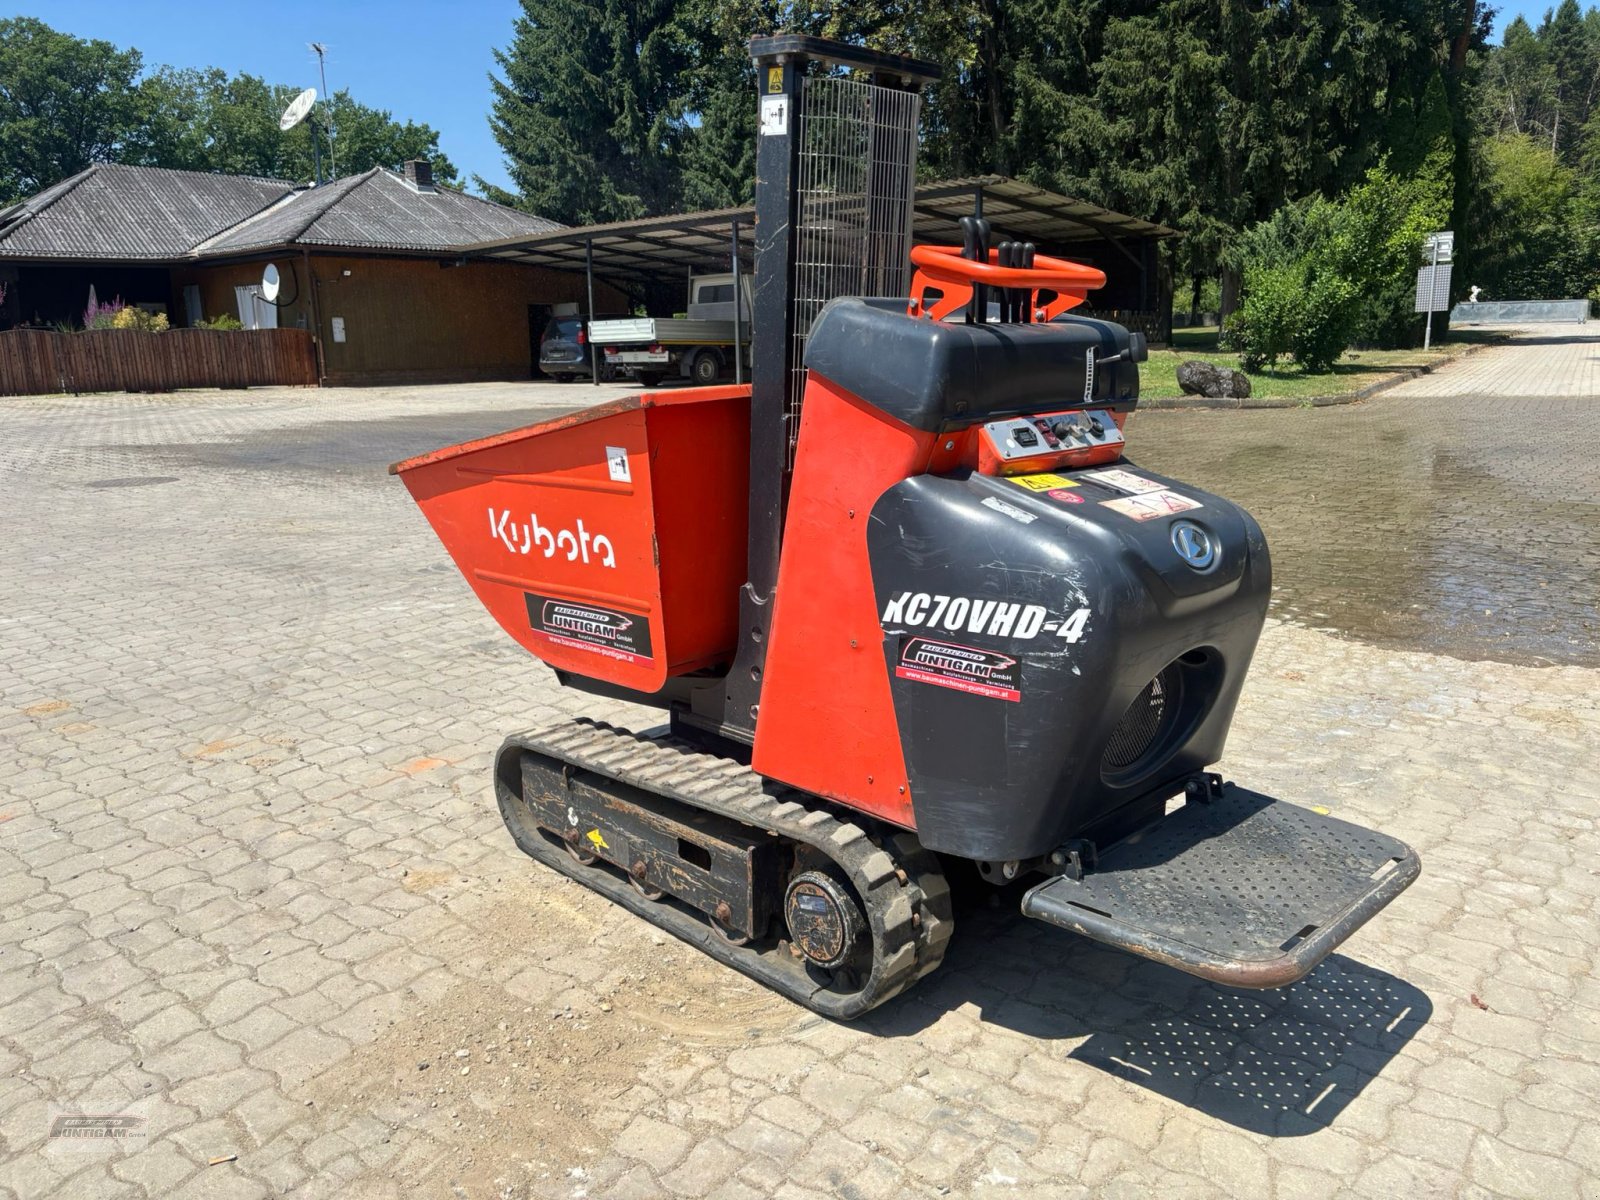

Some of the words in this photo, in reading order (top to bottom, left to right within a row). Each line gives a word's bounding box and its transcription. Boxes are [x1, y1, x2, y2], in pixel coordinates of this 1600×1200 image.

[488, 508, 616, 568] Kubota
[882, 591, 1091, 644] KC70VHD-4
[616, 633, 633, 643] GmbH
[906, 672, 1009, 697] www.baumaschinen-puntigam.at
[991, 672, 1012, 681] GmbH
